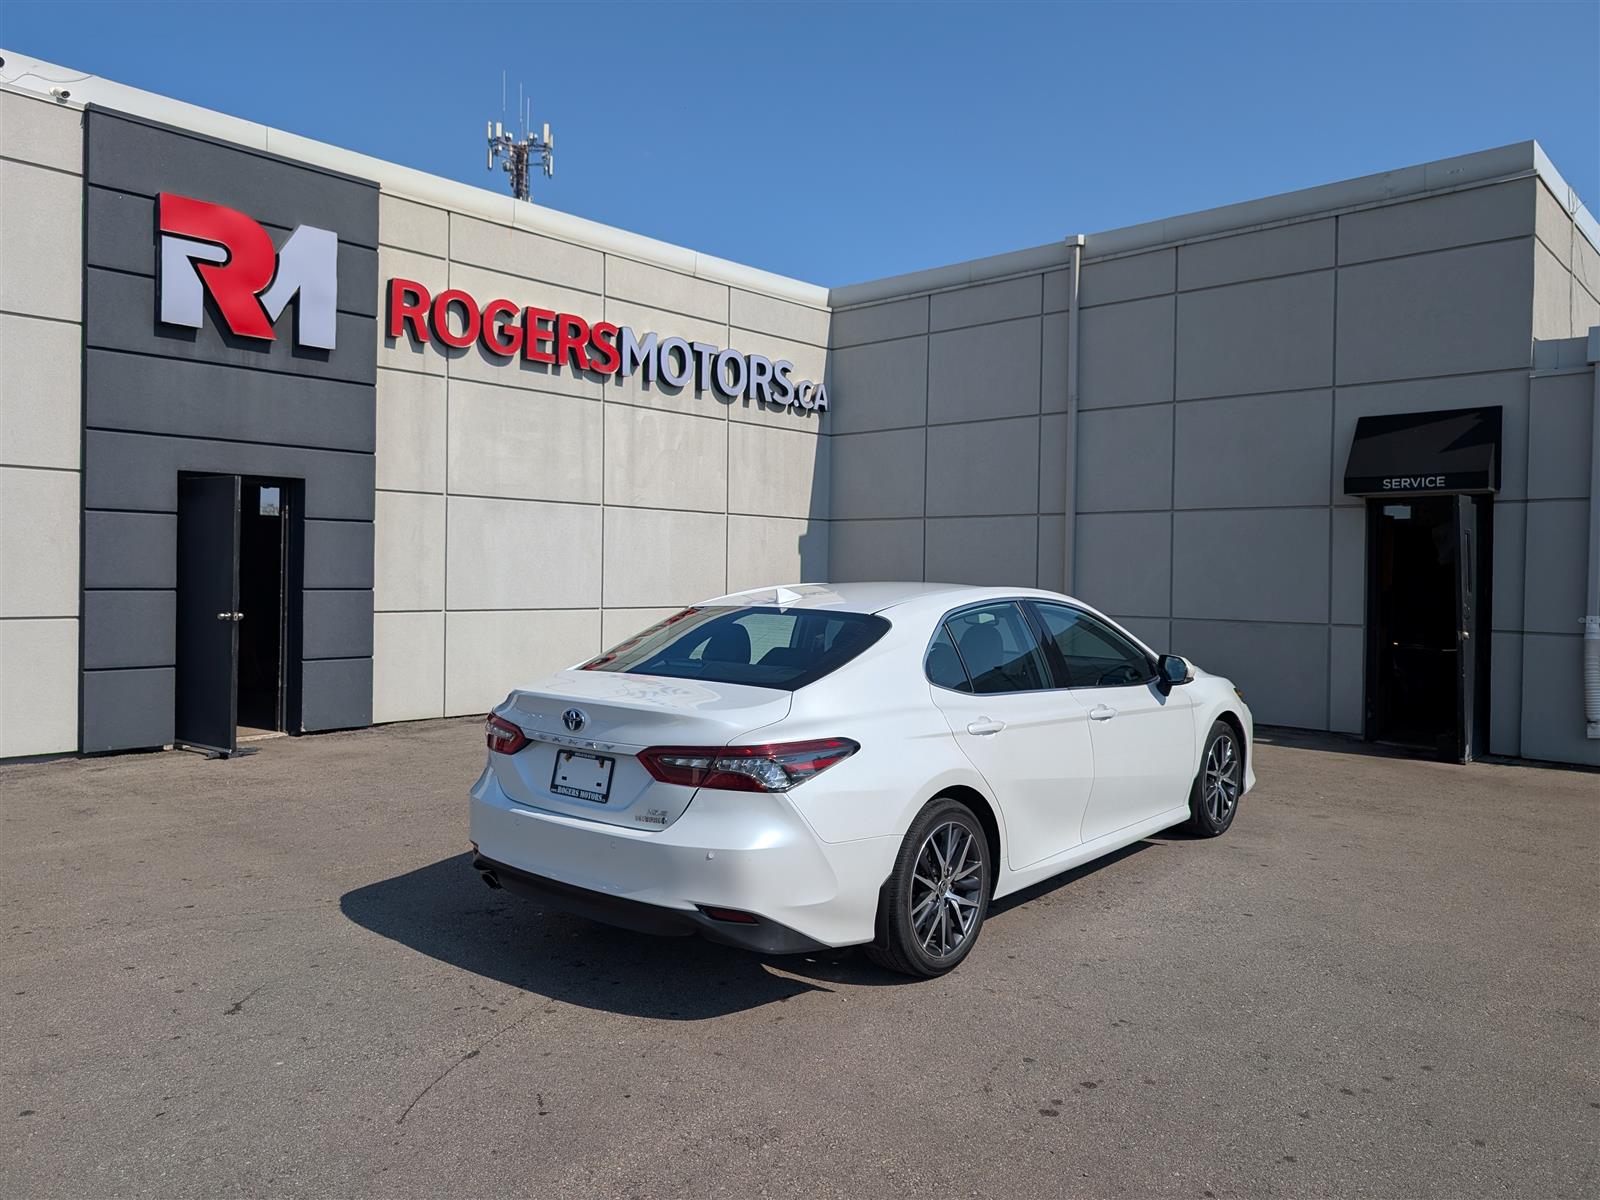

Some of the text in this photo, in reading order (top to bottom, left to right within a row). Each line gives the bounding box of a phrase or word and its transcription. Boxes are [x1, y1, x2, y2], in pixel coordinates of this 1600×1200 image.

[159, 192, 338, 350] RM
[1382, 476, 1446, 490] SERVICE
[557, 786, 602, 802] ROGERS MOTORS
